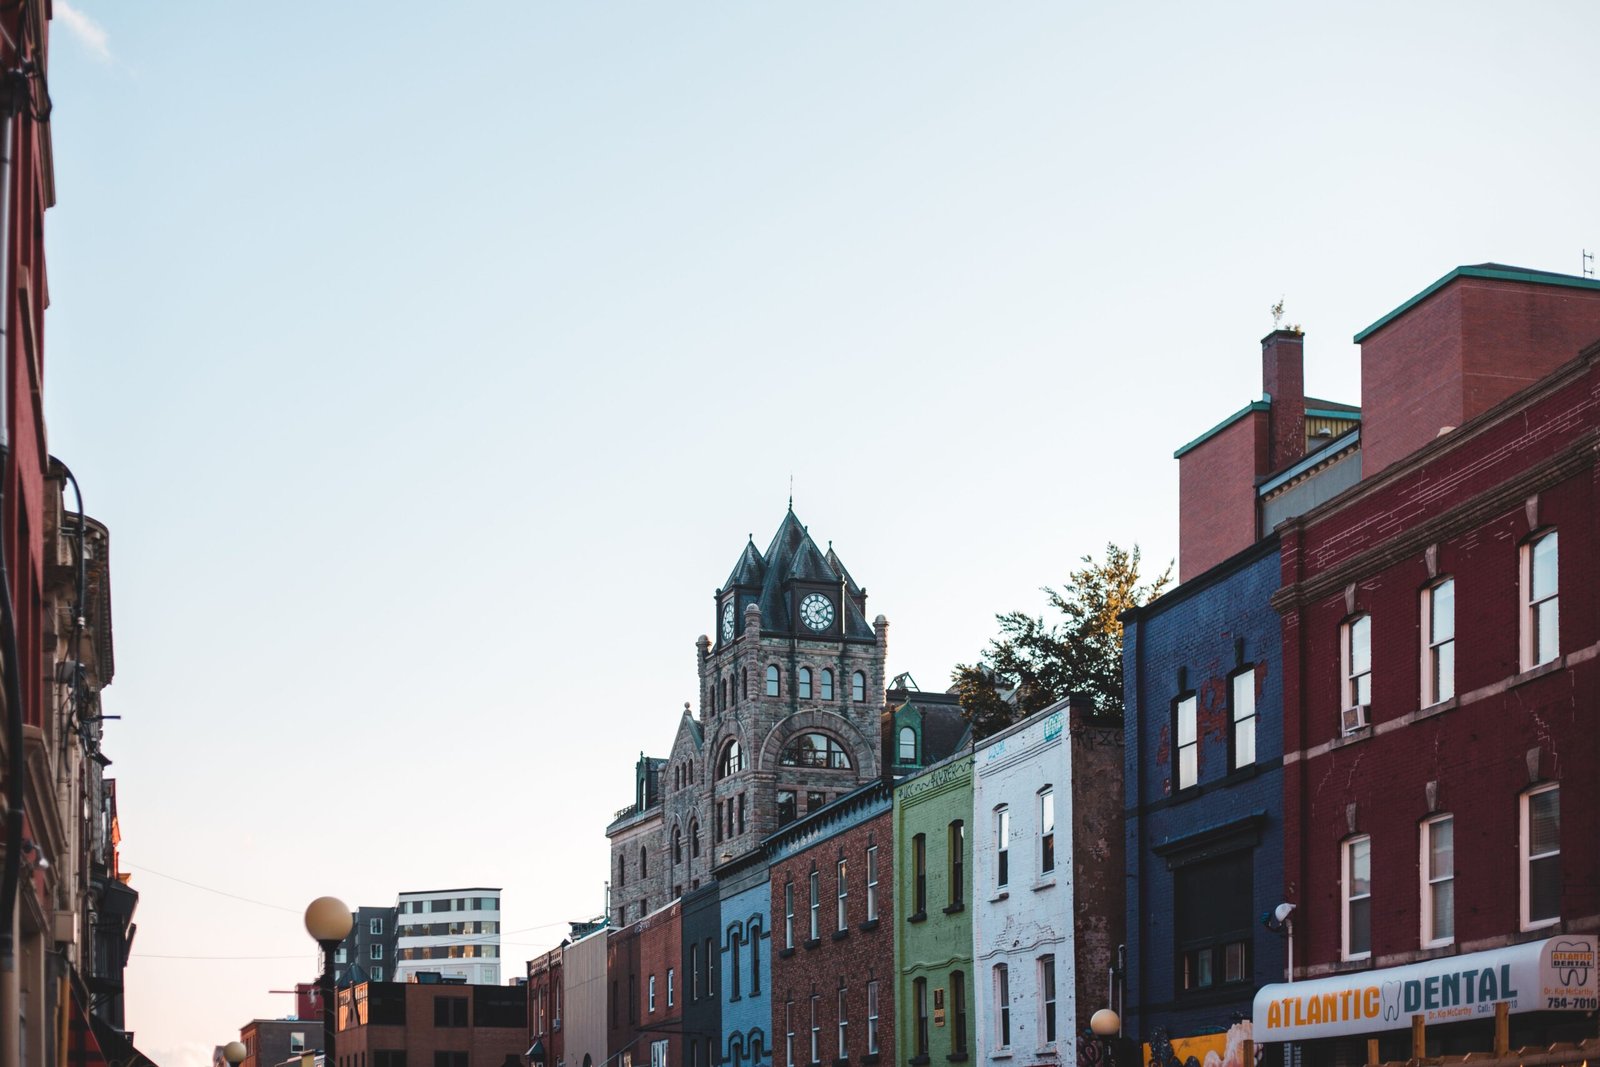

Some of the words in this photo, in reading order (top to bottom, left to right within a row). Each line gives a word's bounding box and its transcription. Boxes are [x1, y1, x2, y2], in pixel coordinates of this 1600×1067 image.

[1266, 986, 1380, 1029] ATLANTIC
[1404, 964, 1518, 1013] DENTAL
[1477, 1003, 1490, 1014] Call:
[1547, 997, 1597, 1009] 754-7010
